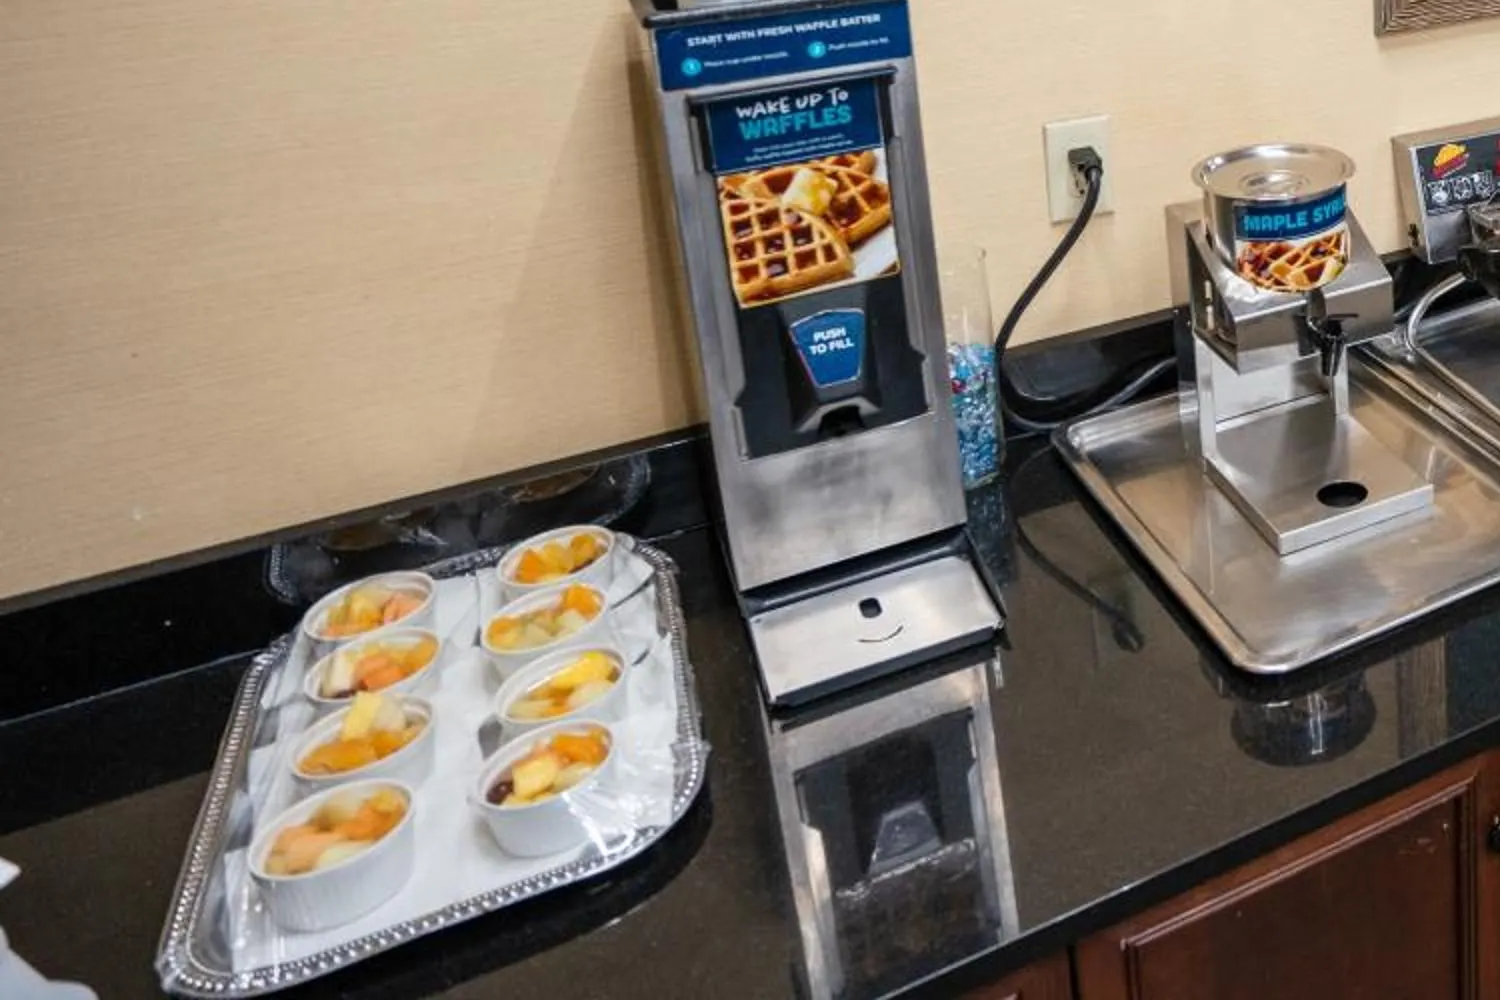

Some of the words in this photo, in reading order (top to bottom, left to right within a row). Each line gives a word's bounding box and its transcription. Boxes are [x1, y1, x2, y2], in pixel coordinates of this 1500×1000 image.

[735, 96, 791, 119] WAKE
[796, 92, 823, 109] UP
[738, 103, 853, 140] WAFFLES
[1243, 211, 1308, 231] MAPLE
[813, 327, 847, 342] PUSH
[809, 343, 827, 355] TO
